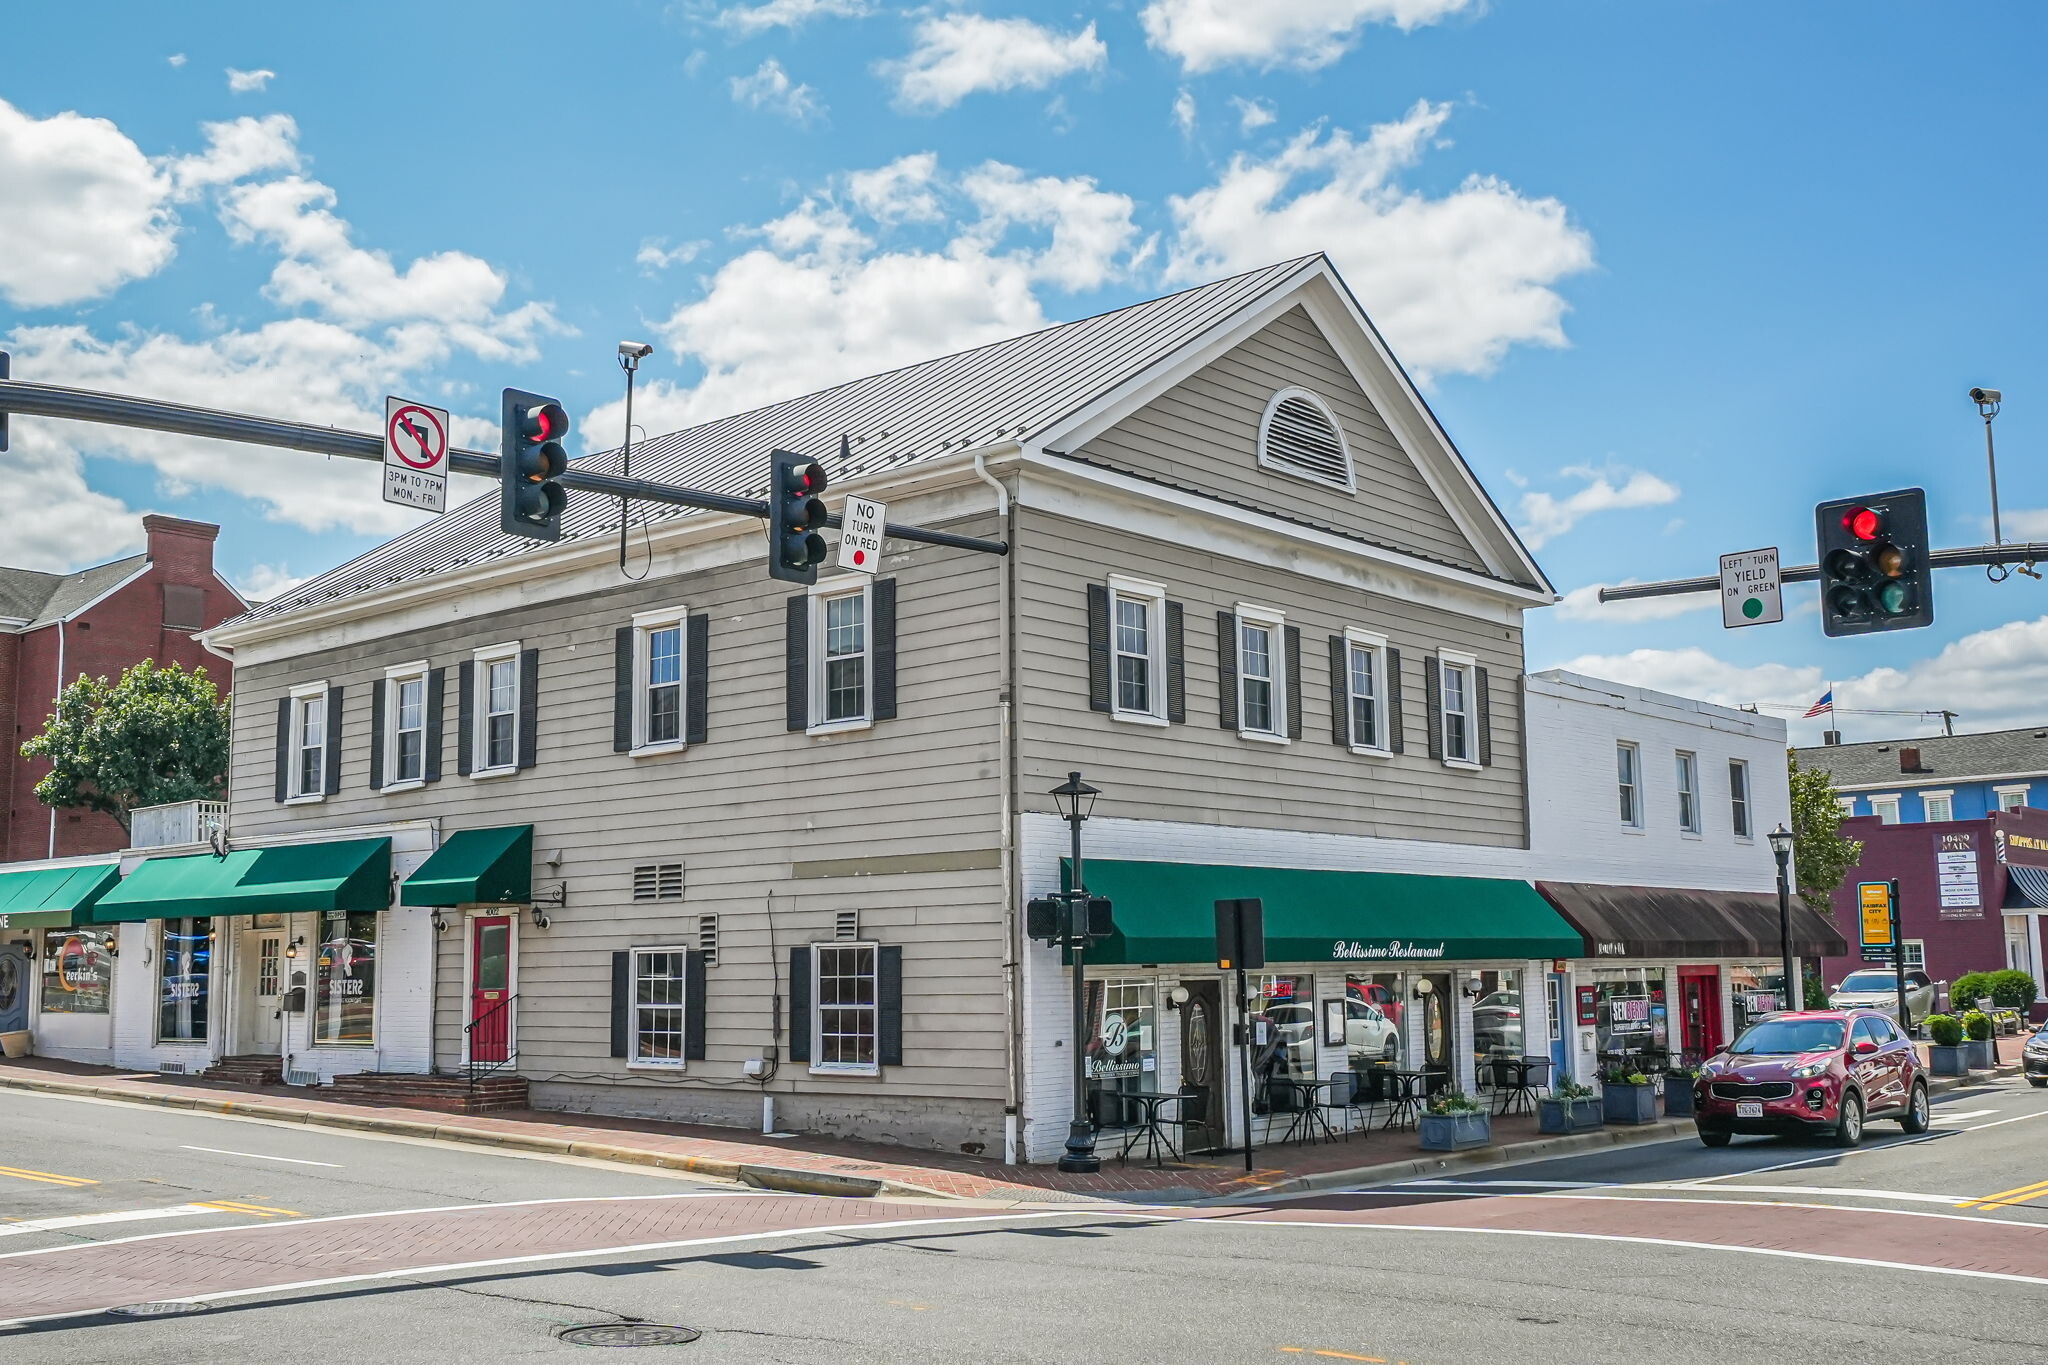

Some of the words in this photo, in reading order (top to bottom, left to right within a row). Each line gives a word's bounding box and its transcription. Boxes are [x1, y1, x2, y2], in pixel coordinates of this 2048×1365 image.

[389, 471, 407, 484] 3PM
[411, 476, 421, 487] TO
[424, 479, 442, 492] 7PM
[422, 494, 436, 505] FRI
[856, 503, 875, 519] NO
[852, 520, 876, 535] TURN
[845, 534, 858, 546] ON
[860, 537, 878, 551] RED
[1723, 559, 1743, 569] LEFT
[1753, 554, 1775, 565] TURN
[1735, 568, 1766, 582] YIELD
[1727, 587, 1739, 597] ON
[1747, 582, 1775, 593] GREEN
[1942, 834, 1970, 843] 10409
[1942, 842, 1970, 851] MAIN
[1332, 940, 1388, 959] Bellissimo
[1388, 940, 1445, 958] Restaurant
[171, 982, 200, 998] SISTERS
[329, 979, 363, 995] SISTERS
[1091, 1059, 1140, 1073] Bellissimo
